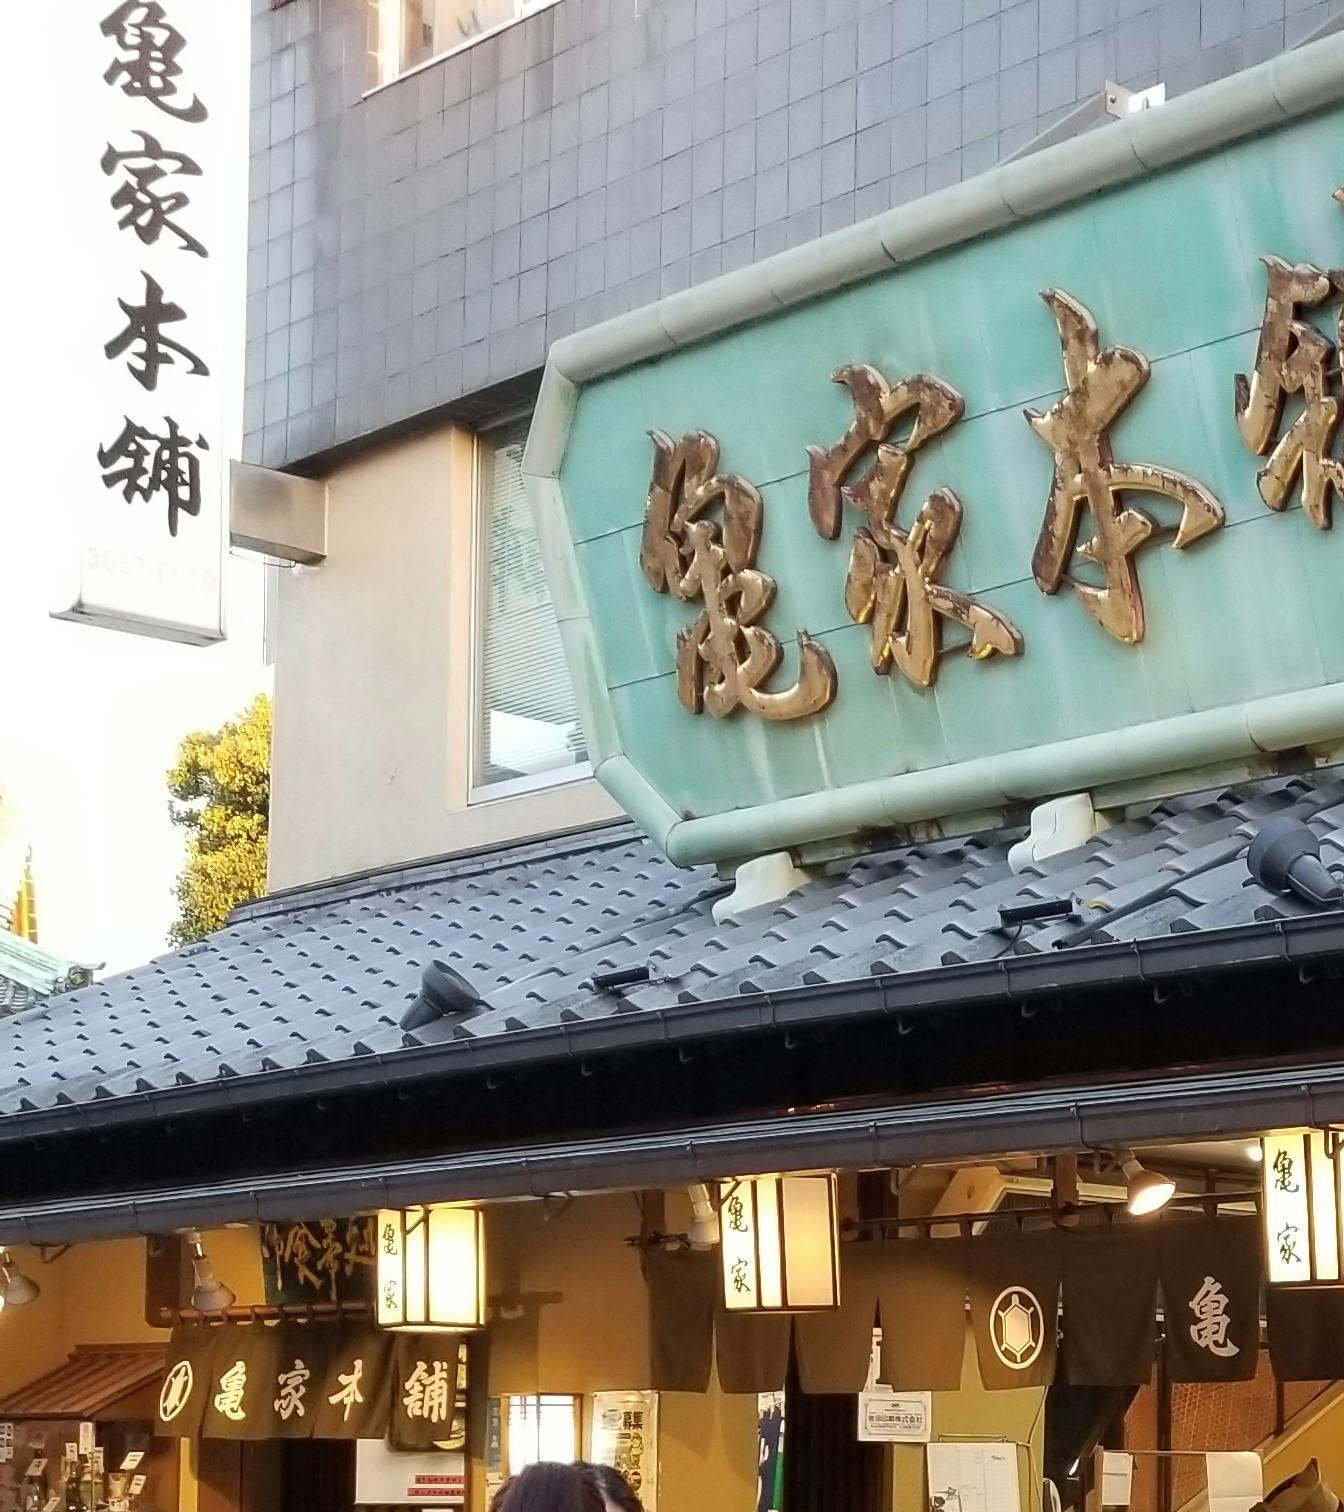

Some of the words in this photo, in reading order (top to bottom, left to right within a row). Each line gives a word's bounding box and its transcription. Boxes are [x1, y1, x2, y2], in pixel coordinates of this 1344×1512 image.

[98, 0, 210, 537] 亀家本舗
[727, 1195, 752, 1294] 亀家
[1272, 1147, 1302, 1266] 亀家
[214, 1360, 448, 1423] 亀家本舗
